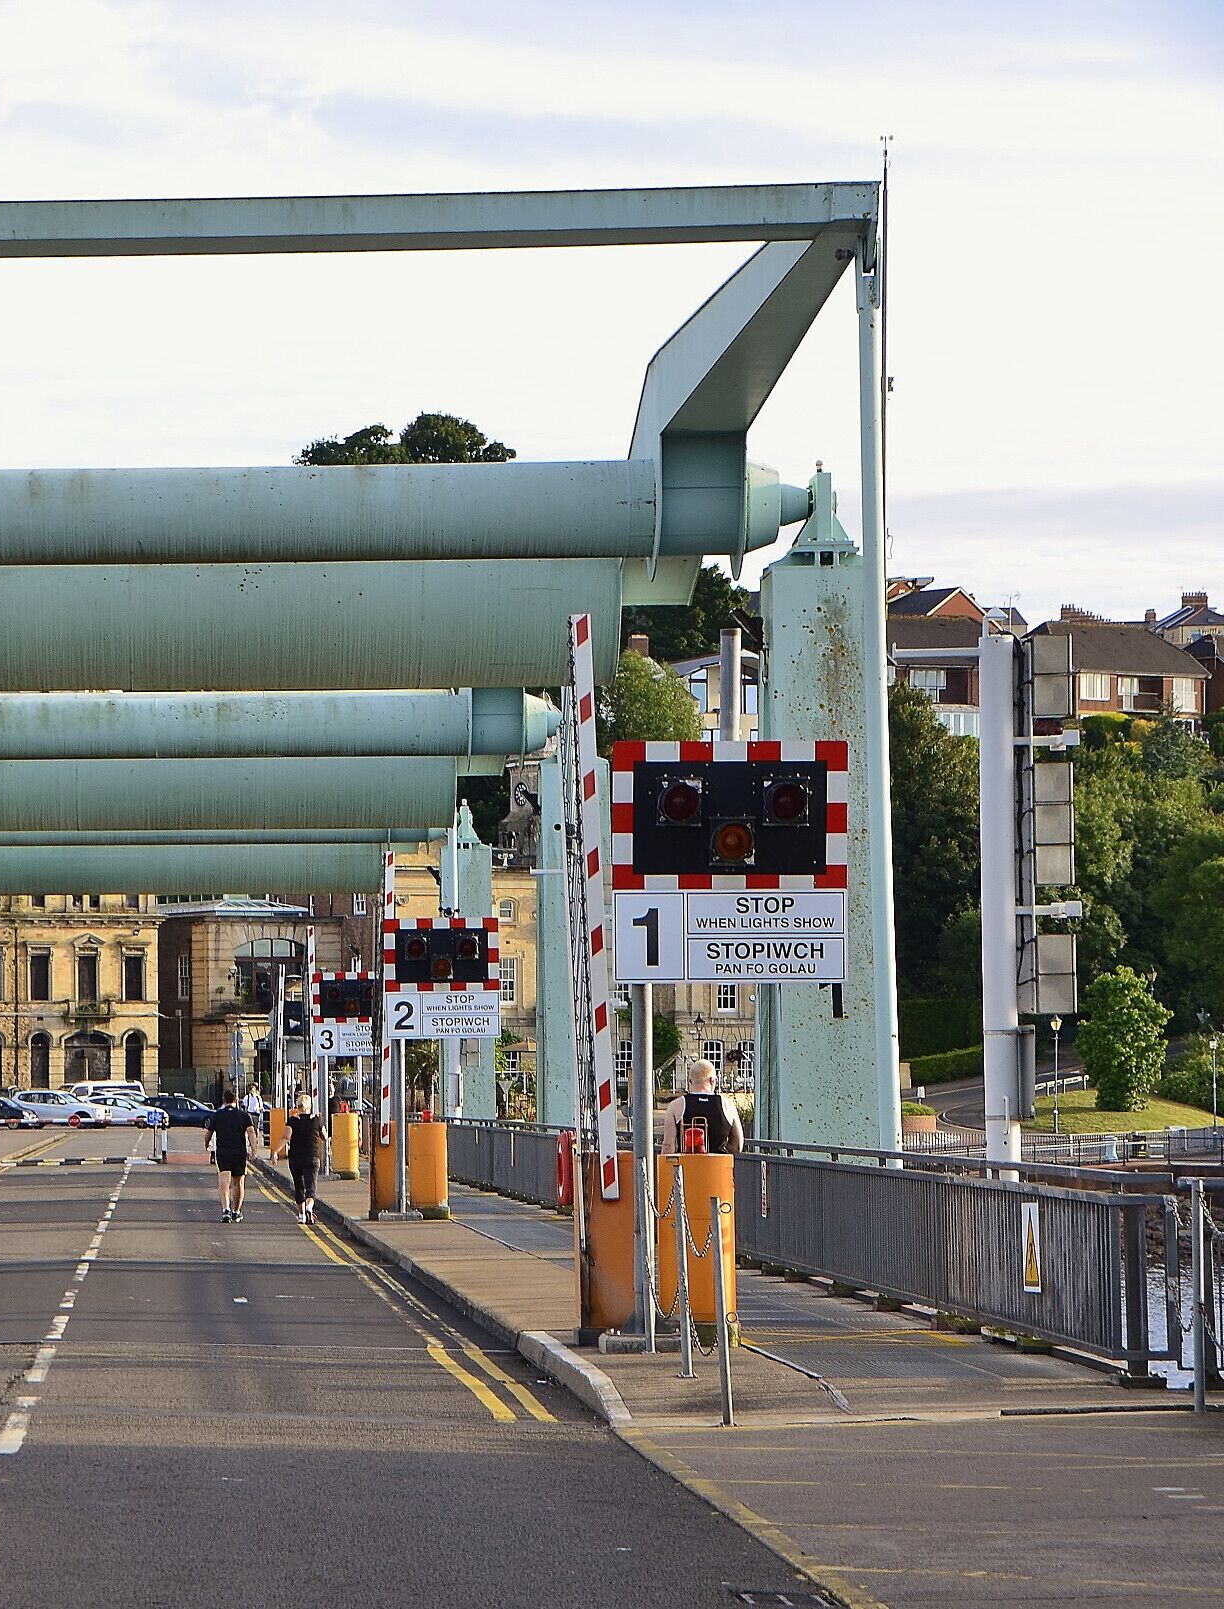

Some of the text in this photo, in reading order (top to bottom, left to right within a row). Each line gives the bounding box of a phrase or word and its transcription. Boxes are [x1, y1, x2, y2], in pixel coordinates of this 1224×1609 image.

[736, 897, 795, 914] STOP
[696, 917, 835, 928] WHEN LIGHTS SHOW
[632, 907, 659, 967] 1
[706, 942, 824, 960] STOPIWCH
[715, 963, 816, 974] PAN FO GOLAU
[445, 994, 475, 1004] STOP
[394, 1001, 415, 1031] 2
[431, 1017, 490, 1027] STOPIWCH
[319, 1029, 334, 1050] 3
